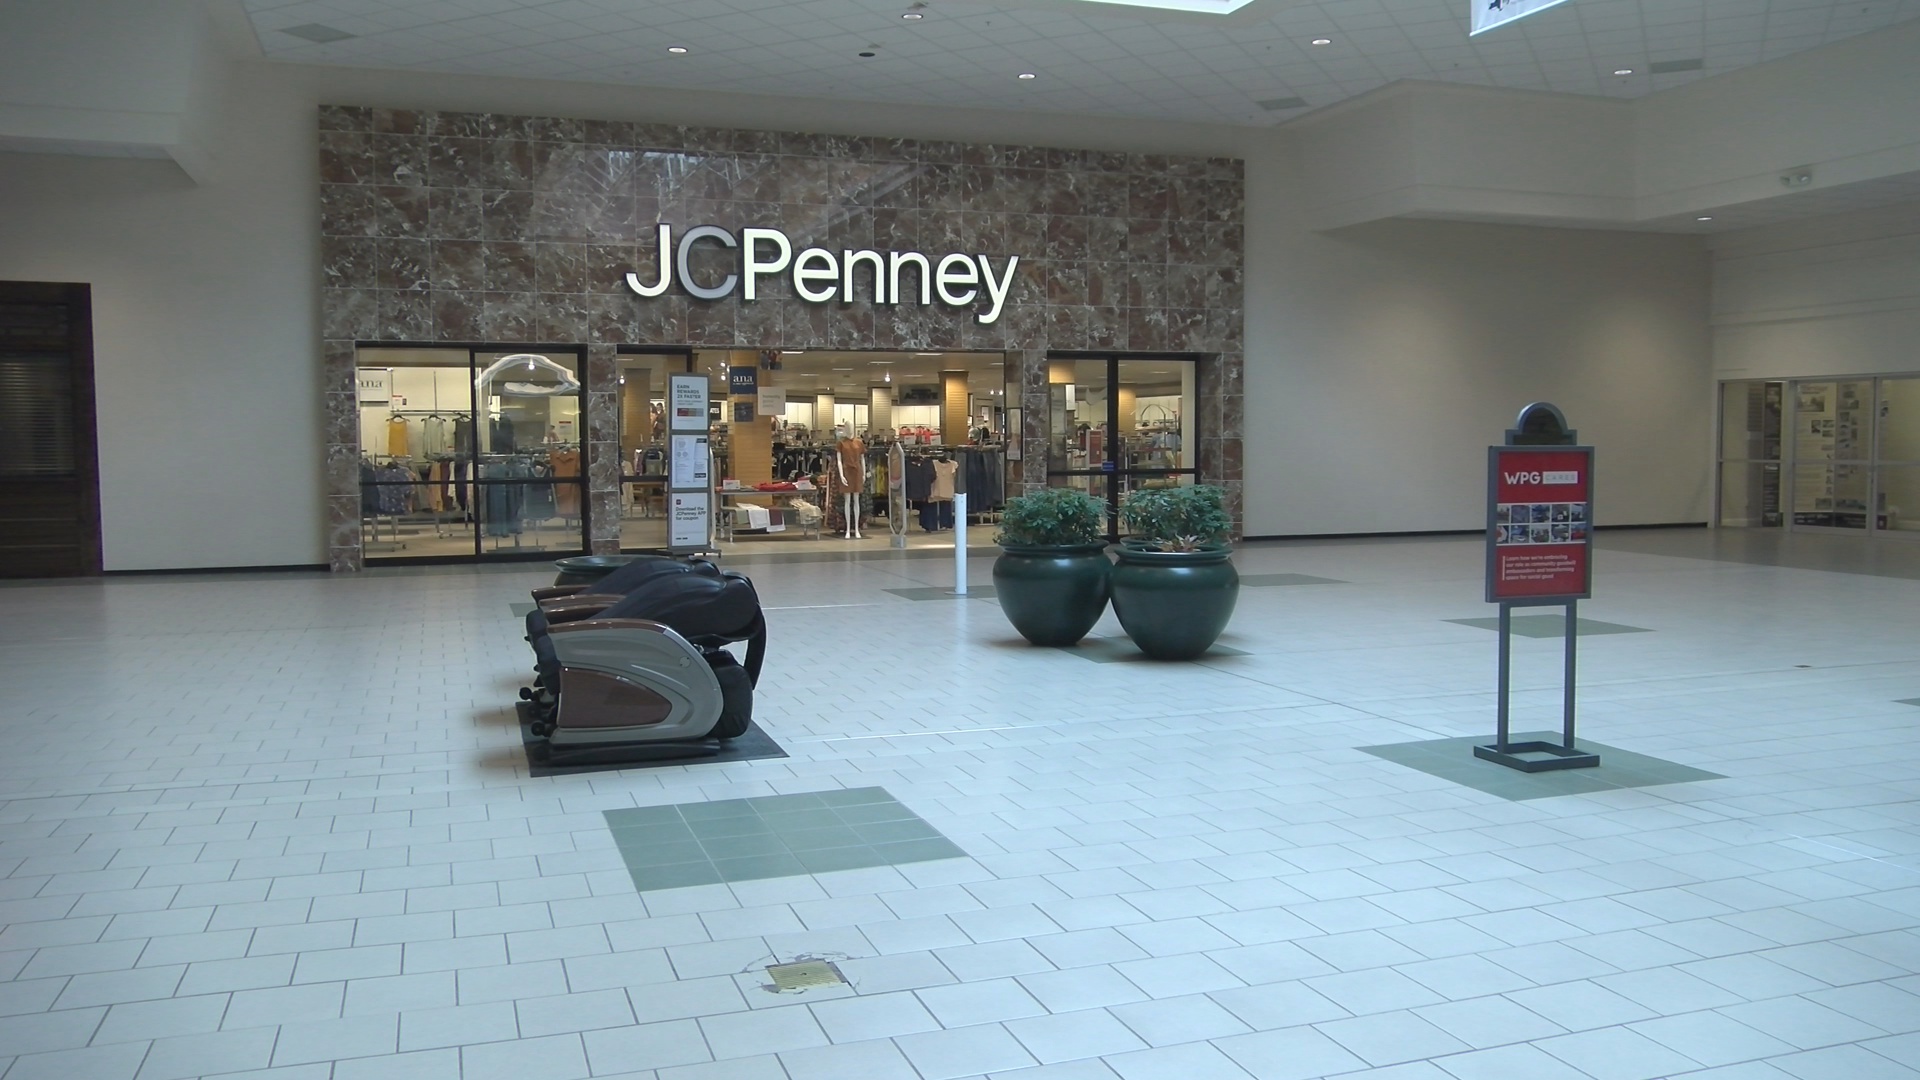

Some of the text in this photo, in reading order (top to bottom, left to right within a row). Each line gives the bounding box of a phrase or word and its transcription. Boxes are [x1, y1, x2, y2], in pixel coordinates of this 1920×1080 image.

[625, 223, 1020, 325] JCPenney
[733, 375, 753, 383] ana
[1504, 471, 1577, 485] WPG CARES
